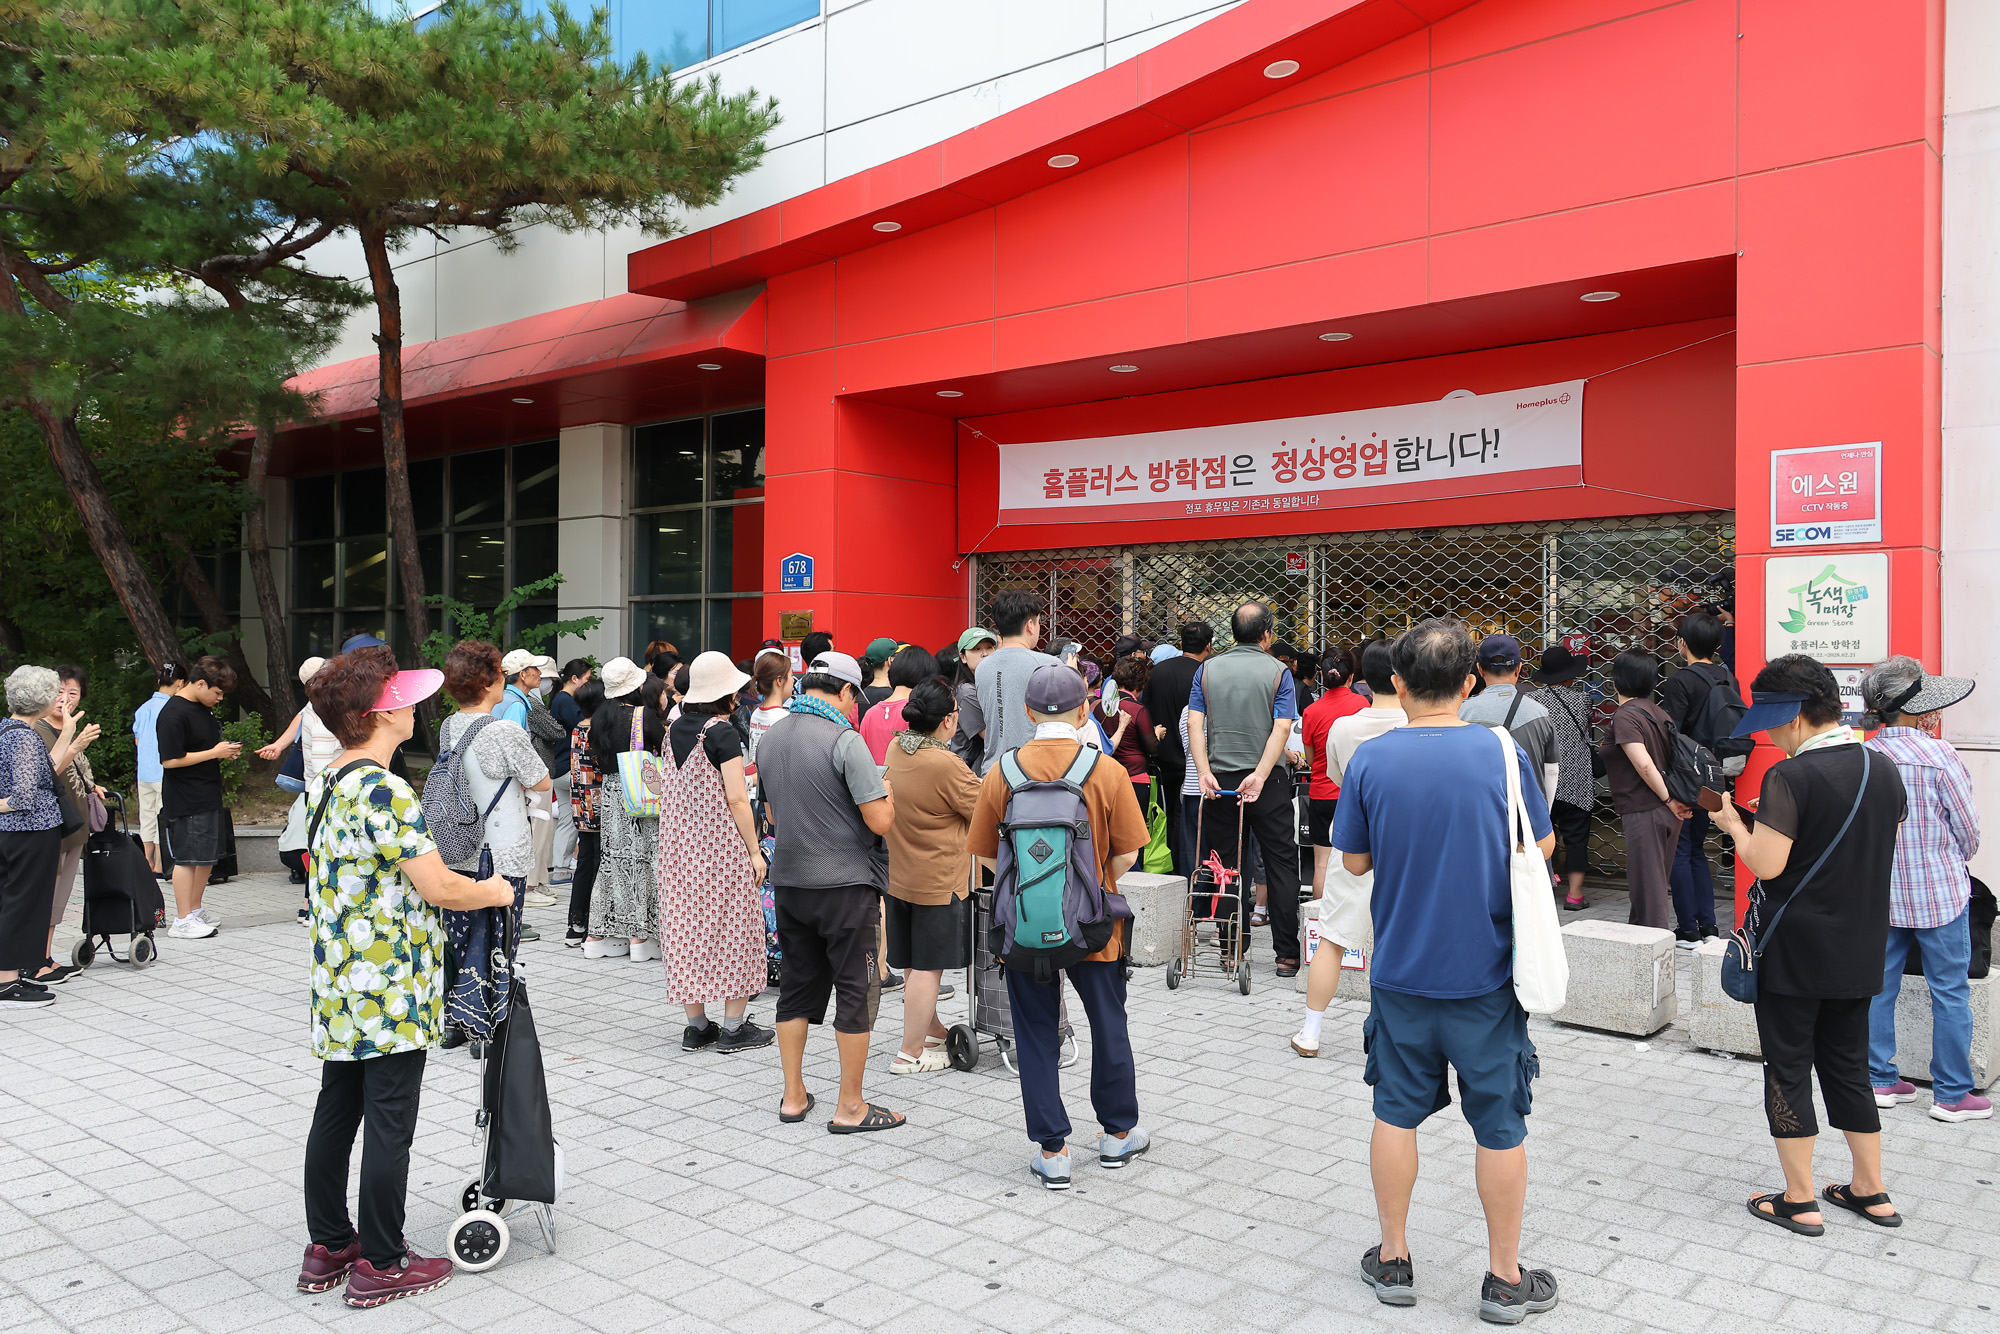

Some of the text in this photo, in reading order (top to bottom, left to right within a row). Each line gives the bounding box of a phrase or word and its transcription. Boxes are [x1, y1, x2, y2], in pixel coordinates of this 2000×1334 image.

[1516, 396, 1558, 410] Homeplus
[1042, 465, 1139, 499] 홈플러스
[1148, 454, 1257, 493] 방학점은
[1791, 471, 1858, 498] 에스원
[1185, 494, 1320, 515] 점포 휴무일은 기존과 동일합니다
[1801, 501, 1849, 512] CCTV 작동중
[1776, 526, 1831, 542] SECOM
[788, 560, 807, 574] 678
[1806, 580, 1844, 614] 녹색
[1823, 604, 1857, 618] 매장
[1807, 619, 1854, 627] Green Store
[1790, 639, 1861, 650] 홈플러스 방학점
